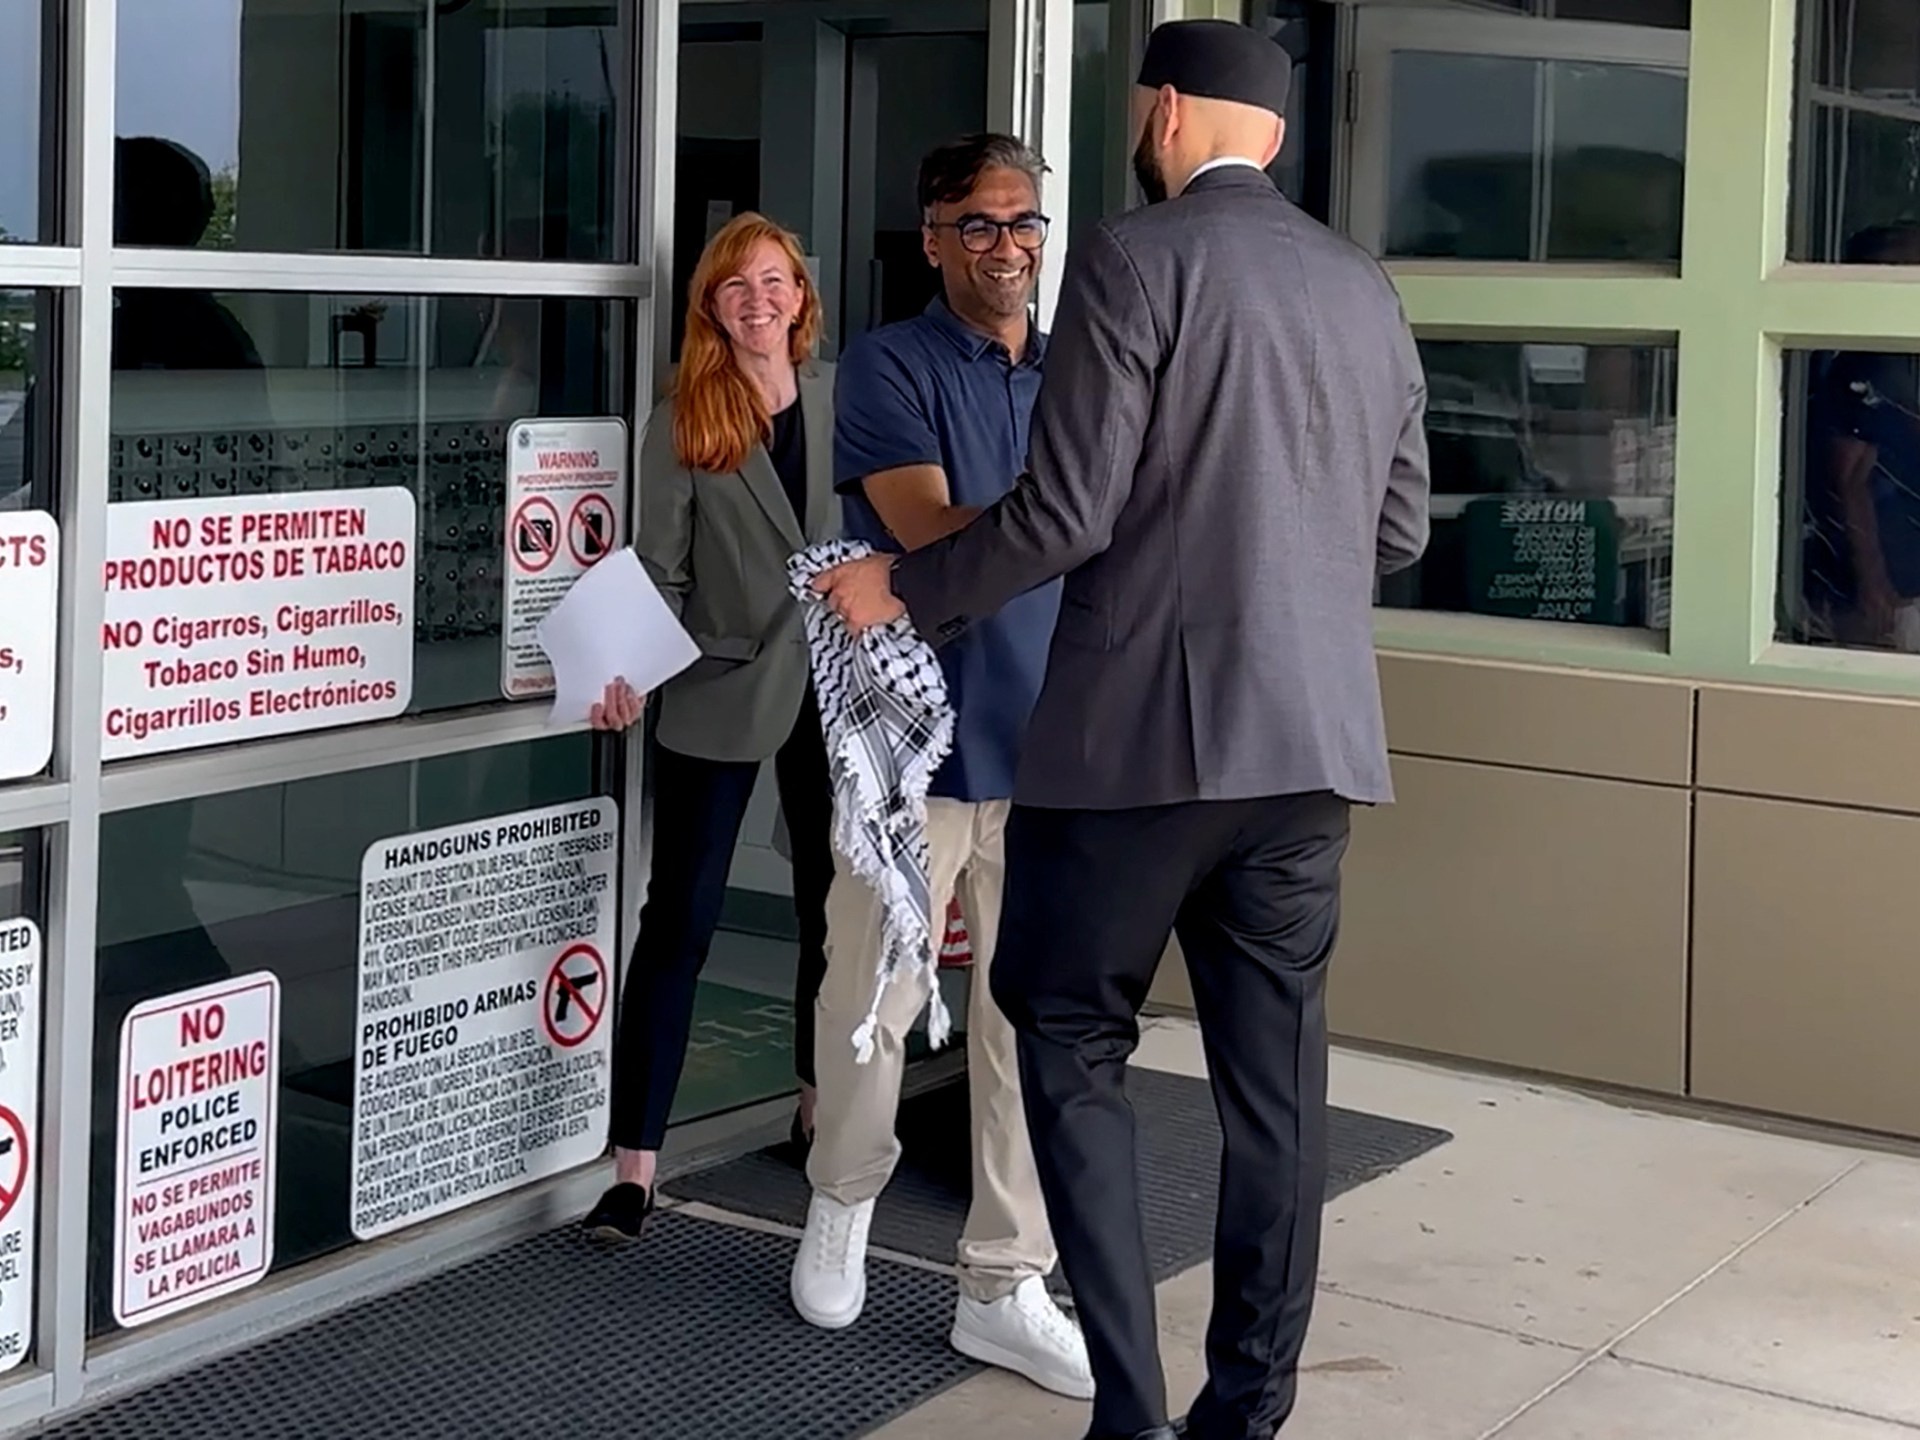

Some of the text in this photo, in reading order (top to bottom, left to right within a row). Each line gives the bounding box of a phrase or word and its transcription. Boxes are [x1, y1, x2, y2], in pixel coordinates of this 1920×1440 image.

[538, 450, 599, 469] WARNING
[153, 508, 366, 550] NO SE PERMITEN
[105, 540, 406, 592] PRODUCTOS DE TABACO
[103, 599, 403, 651] NO Cigarros, Cigarrillos,
[145, 644, 367, 689] Tobaco Sin Humo,
[105, 678, 397, 740] Cigarrillos Electrónicos
[384, 809, 601, 868] HANDGUNS PROHIBITED
[181, 1004, 225, 1048] NO
[363, 980, 536, 1043] PROHIBIDO ARMAS
[362, 1025, 458, 1069] DE FUEGO
[132, 1041, 266, 1110] LOITERING
[160, 1091, 240, 1135] POLICE
[139, 1118, 257, 1173] ENFORCED
[131, 1158, 261, 1219] NO SE PERMITE
[138, 1190, 253, 1244] VAGABUNDOS
[133, 1216, 255, 1275] SE LLAMARA A
[148, 1250, 242, 1299] LA POLICIA
